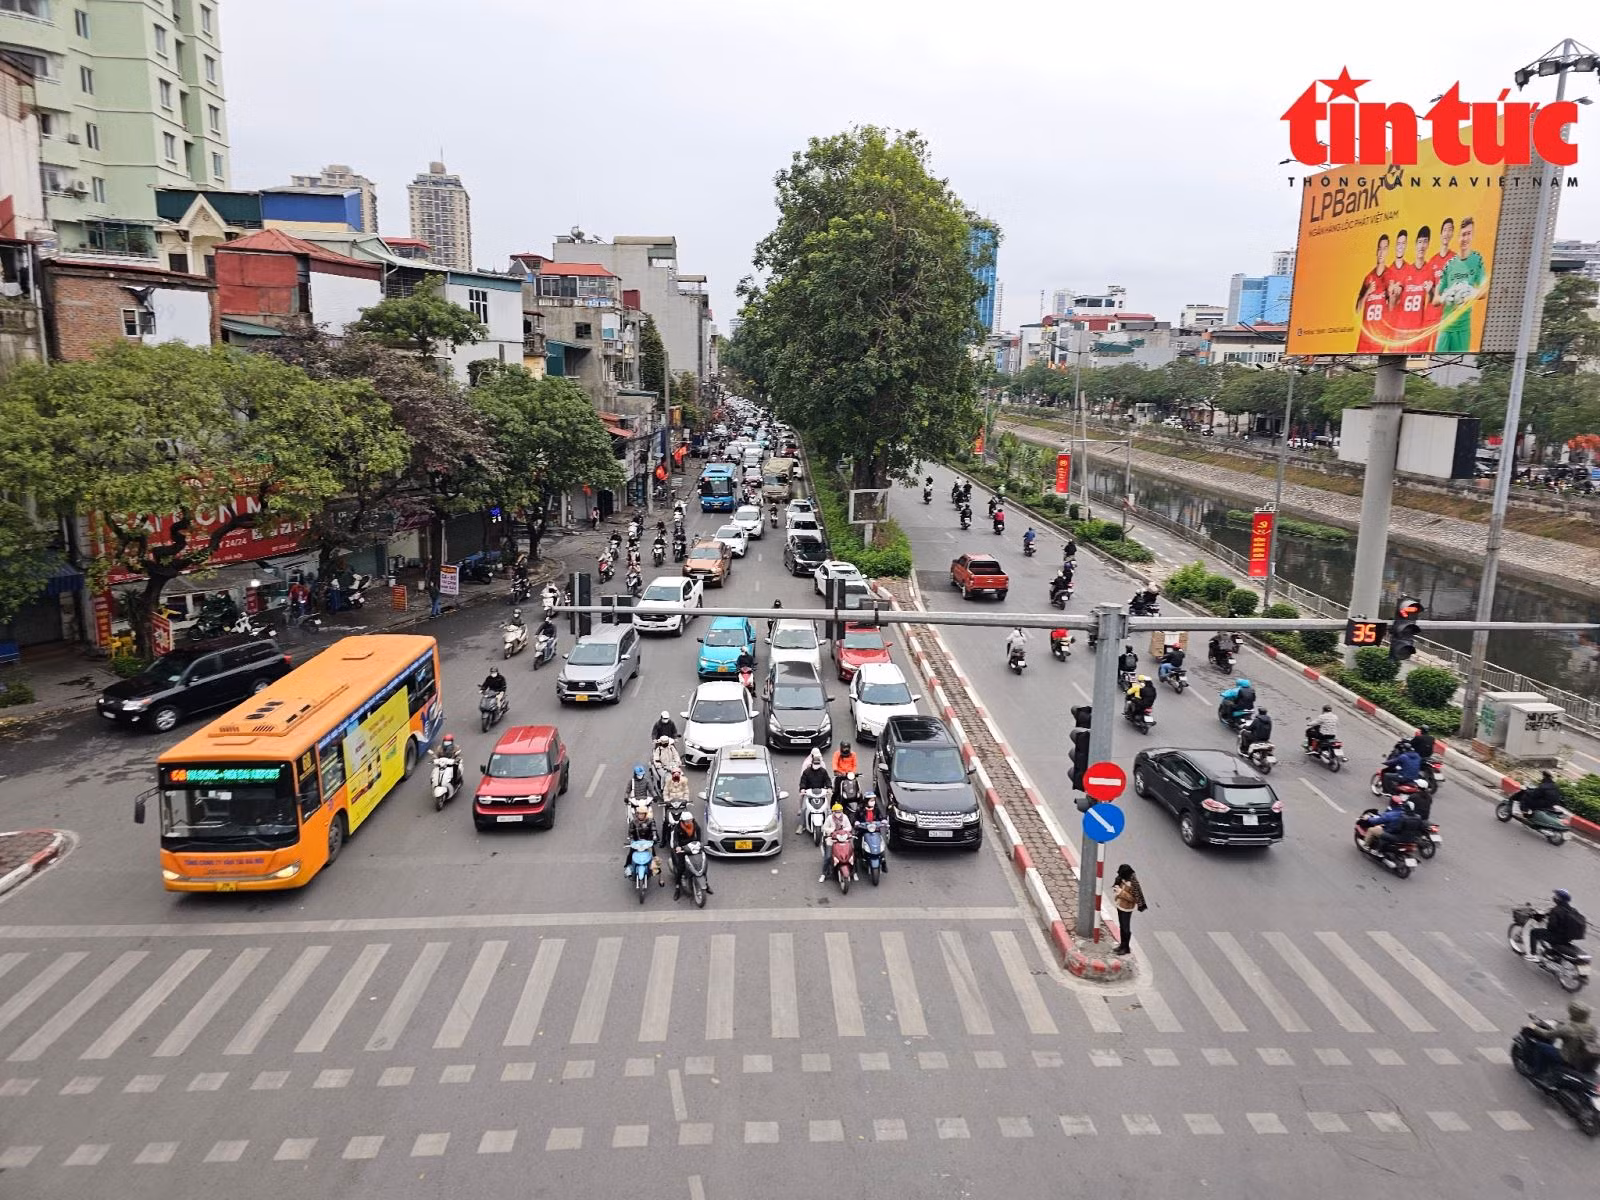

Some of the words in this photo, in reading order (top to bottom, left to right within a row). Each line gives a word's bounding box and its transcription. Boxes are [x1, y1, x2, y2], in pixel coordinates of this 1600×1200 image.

[1310, 179, 1380, 223] LPBank
[1366, 304, 1383, 321] 68
[1404, 295, 1422, 312] 68
[1352, 623, 1377, 643] 35
